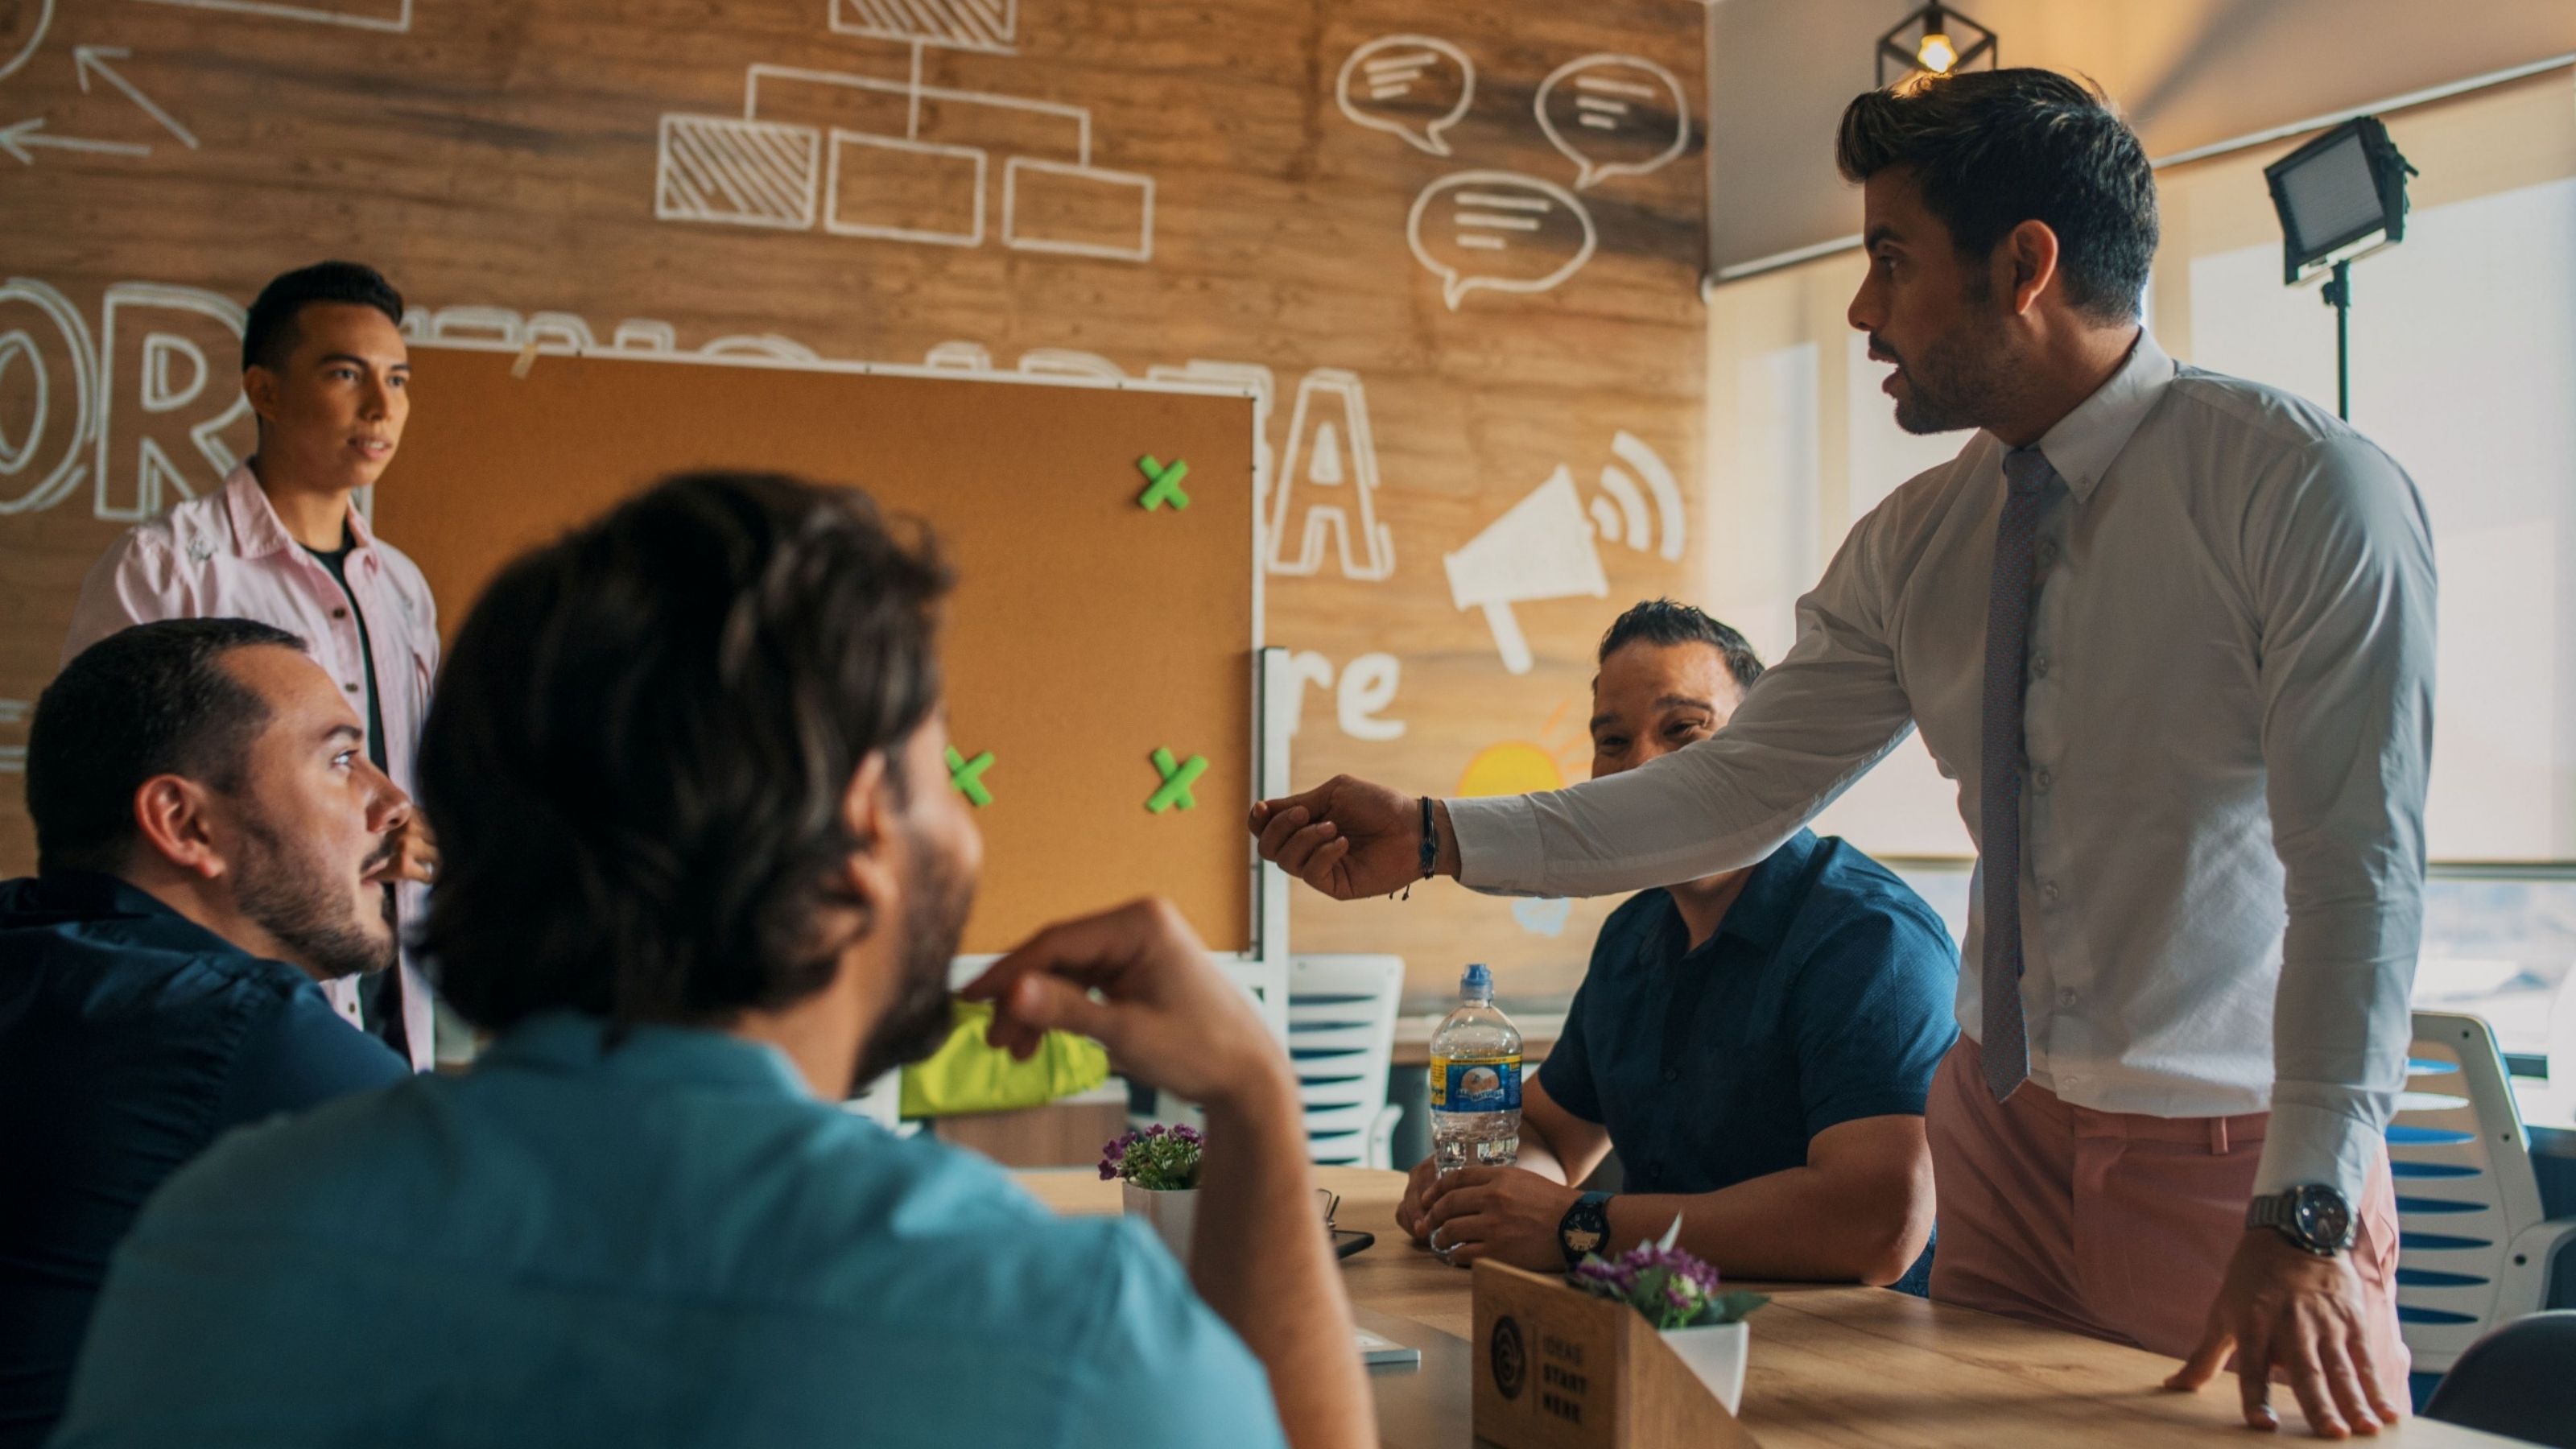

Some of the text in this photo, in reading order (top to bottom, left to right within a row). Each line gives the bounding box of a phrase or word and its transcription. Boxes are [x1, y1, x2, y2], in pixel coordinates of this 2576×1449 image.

[1282, 650, 1406, 741] re
[1543, 1363, 1587, 1396] START
[1543, 1392, 1583, 1424] HERE
